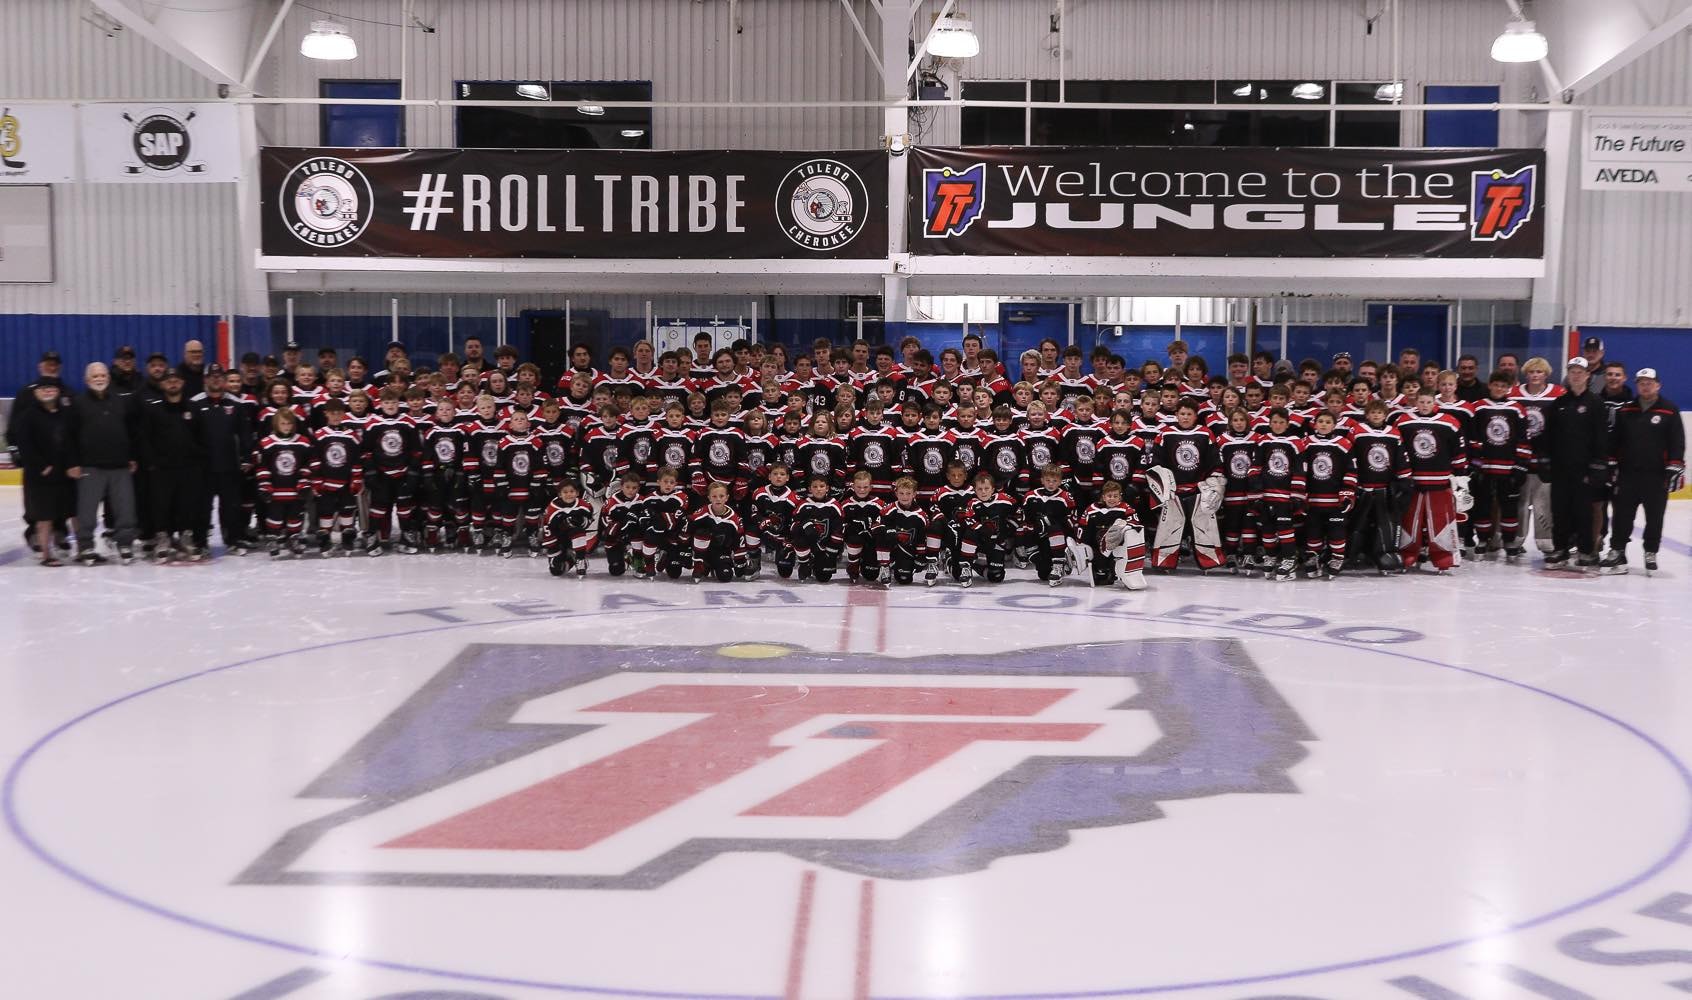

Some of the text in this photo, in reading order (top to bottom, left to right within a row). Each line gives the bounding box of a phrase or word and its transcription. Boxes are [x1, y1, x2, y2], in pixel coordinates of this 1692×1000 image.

[140, 132, 183, 156] SAP
[1595, 135, 1685, 152] The Future
[301, 161, 354, 179] TOLEDO
[798, 164, 850, 181] TOLEDO
[998, 162, 1454, 199] Welcome to the
[1595, 168, 1658, 183] AVEDA
[987, 202, 1467, 231] JUNGLE
[293, 222, 359, 244] CHEROKEE
[794, 225, 854, 247] CHEROKEE
[814, 395, 826, 406] 43
[386, 589, 1427, 645] TEAM TOLEDO
